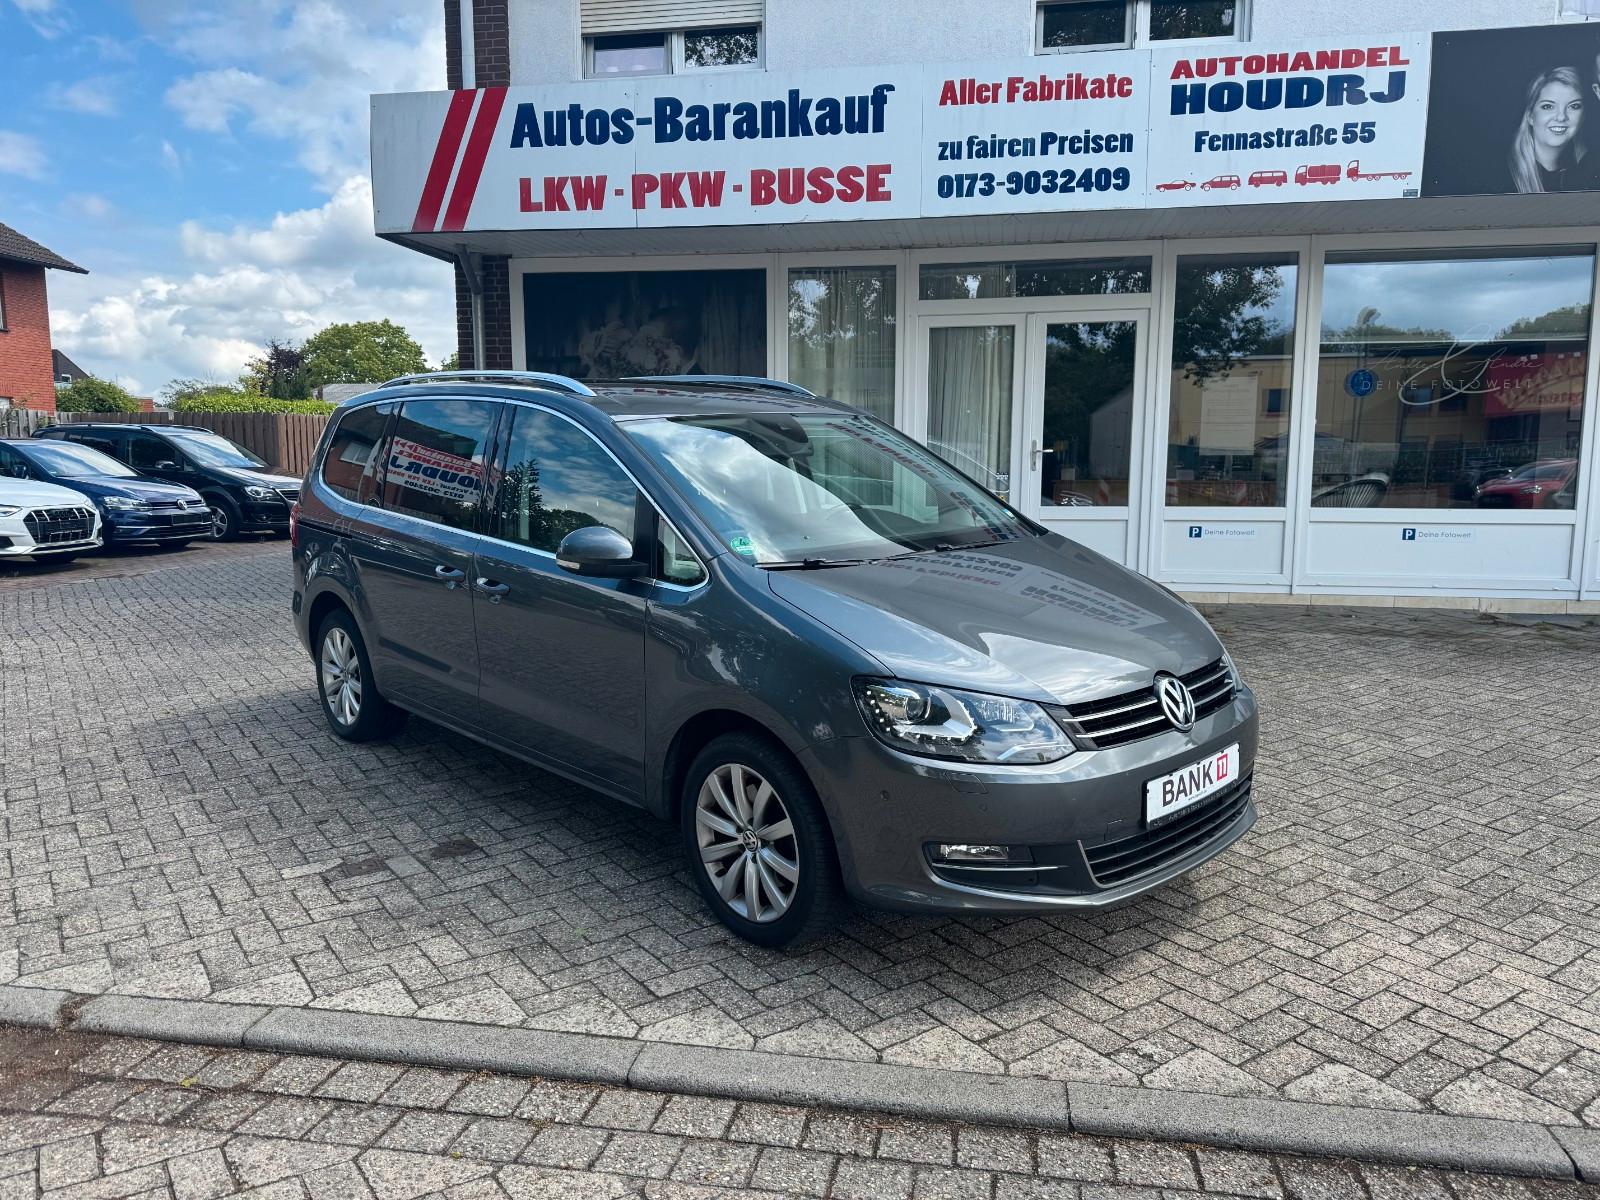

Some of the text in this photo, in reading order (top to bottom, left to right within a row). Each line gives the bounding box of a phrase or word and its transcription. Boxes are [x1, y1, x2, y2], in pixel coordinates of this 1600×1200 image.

[1170, 46, 1410, 80] AUTOHANDEL
[939, 73, 1134, 106] Aller Fabrikate
[1170, 71, 1406, 116] HOUDRJ
[510, 84, 896, 149] Autos-Barankauf
[937, 128, 1134, 161] zu fairen Preisen
[1194, 122, 1377, 154] Fennastraße 55
[518, 164, 892, 213] LKW PKW BUSSE
[937, 167, 1131, 199] 0173-9032409
[1361, 378, 1533, 390] DEINE FOTOWELT
[1162, 761, 1214, 807] BANK
